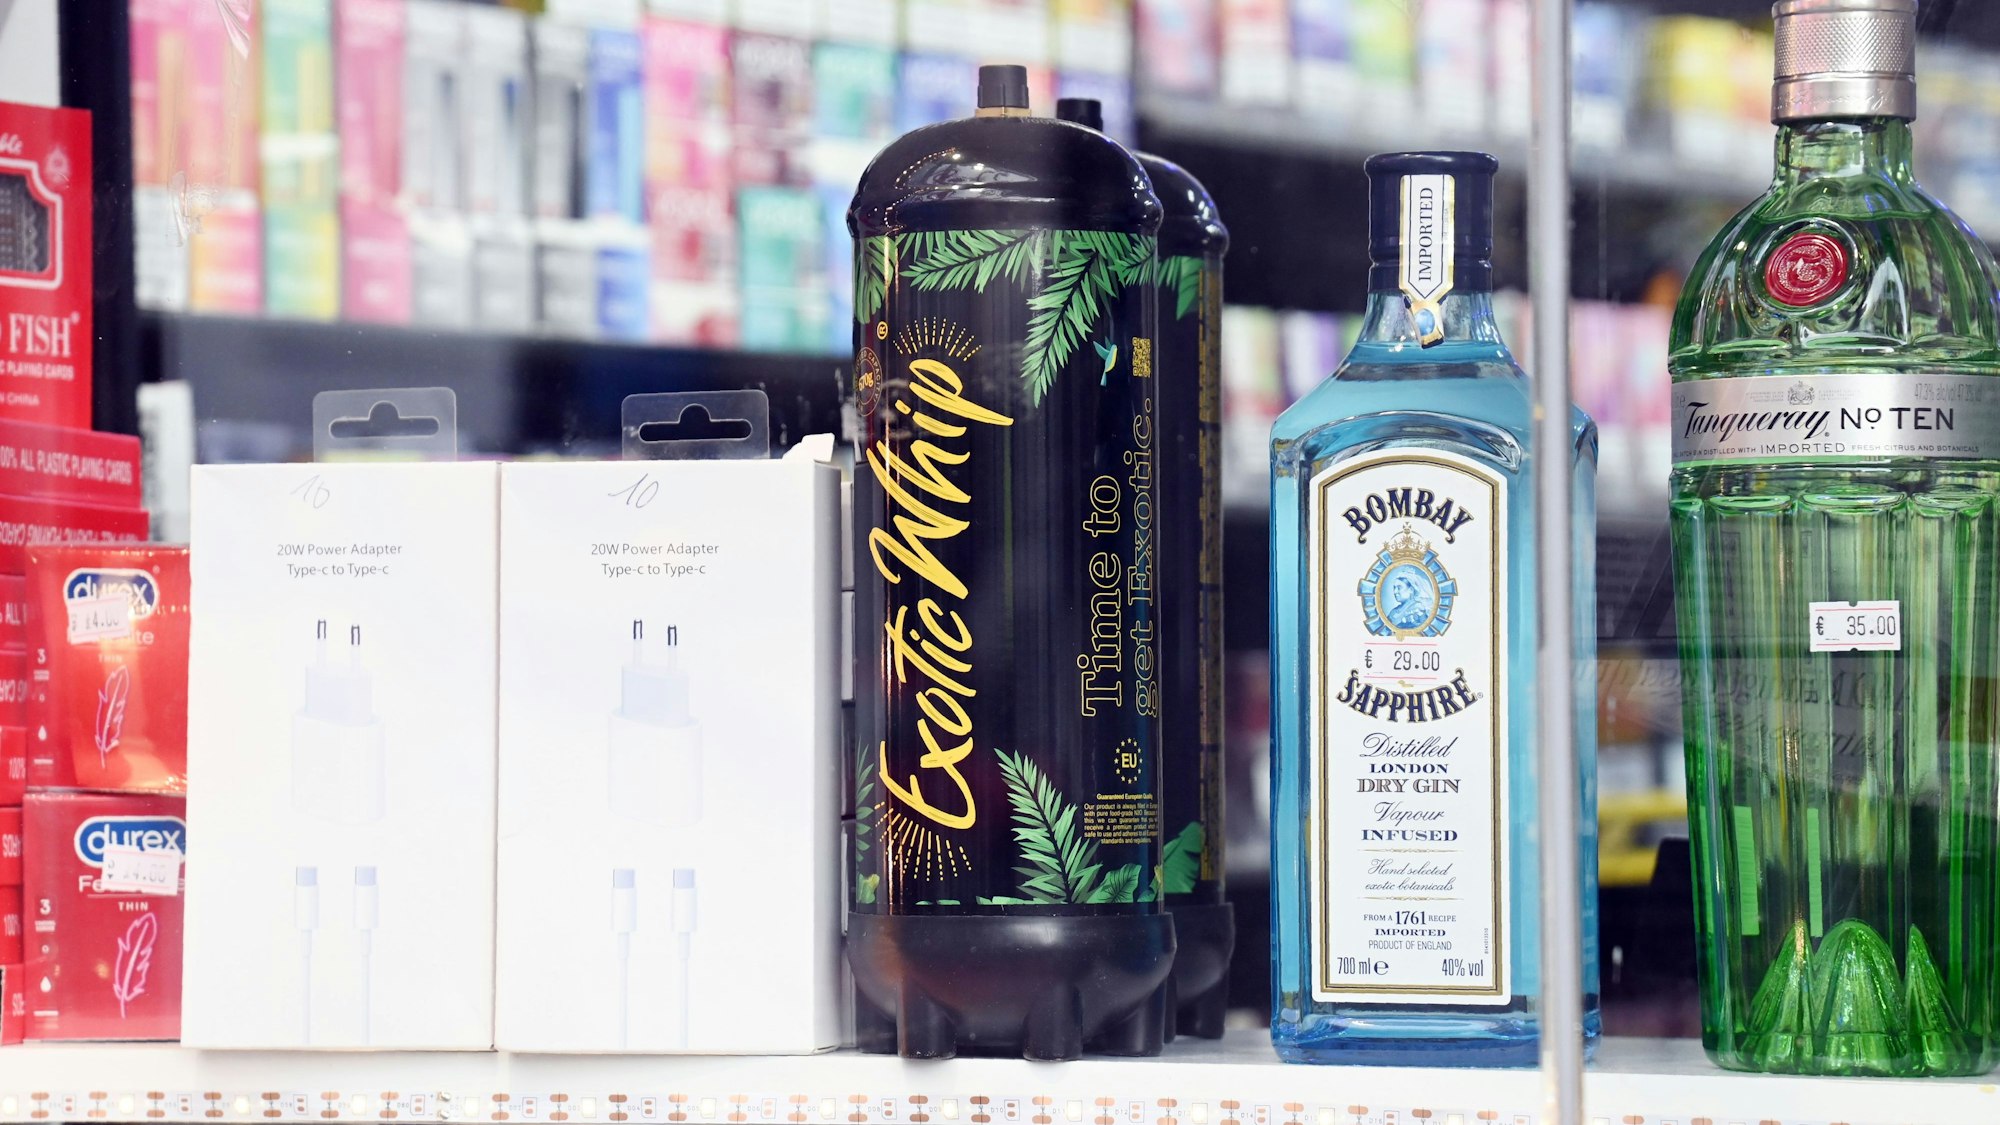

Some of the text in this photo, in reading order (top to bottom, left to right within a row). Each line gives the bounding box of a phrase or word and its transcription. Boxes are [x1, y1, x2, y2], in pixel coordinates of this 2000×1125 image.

[1418, 187, 1433, 282] IMPORTED
[9, 313, 71, 358] FISH
[1684, 401, 1831, 443] Tanqueray
[1889, 407, 1954, 430] TEN
[1704, 447, 1736, 456] DISTILLED
[1760, 443, 1846, 454] IMPORTED
[1937, 445, 1980, 453] BOTANICALS
[1342, 487, 1475, 544] BOMBAY
[277, 543, 402, 557] 20W Power Adapter
[591, 542, 719, 557] 20W Power Adapter
[287, 562, 389, 578] Type-c to Type-c
[602, 562, 706, 578] Type-c to Type-c
[1077, 475, 1122, 717] Time to
[1816, 615, 1896, 636] € 35.00
[1364, 649, 1440, 671] € 29.00
[1127, 620, 1158, 718] get
[1336, 667, 1478, 723] SAPPHIRE
[1359, 732, 1459, 758] Distilled
[1121, 753, 1137, 769] EU
[1369, 763, 1449, 774] LONDON
[1357, 778, 1461, 793] DRY GIN
[1096, 803, 1116, 811] product
[1374, 801, 1445, 827] Vapour
[87, 823, 181, 854] durex
[1361, 829, 1458, 842] INFUSED
[1367, 858, 1452, 876] Hand selected
[1365, 876, 1456, 891] exotic botanicals
[40, 899, 51, 915] 3
[118, 901, 149, 911] THIN
[1363, 914, 1386, 922] FROM
[1387, 914, 1393, 922] A
[1395, 910, 1427, 925] 1761
[1375, 928, 1446, 937] IMPORTED
[1369, 939, 1452, 950] PRODUCT OF ENGLAND
[1337, 957, 1355, 975] 700
[1358, 957, 1371, 975] ml
[1441, 958, 1465, 977] 40%
[1468, 959, 1484, 977] vol
